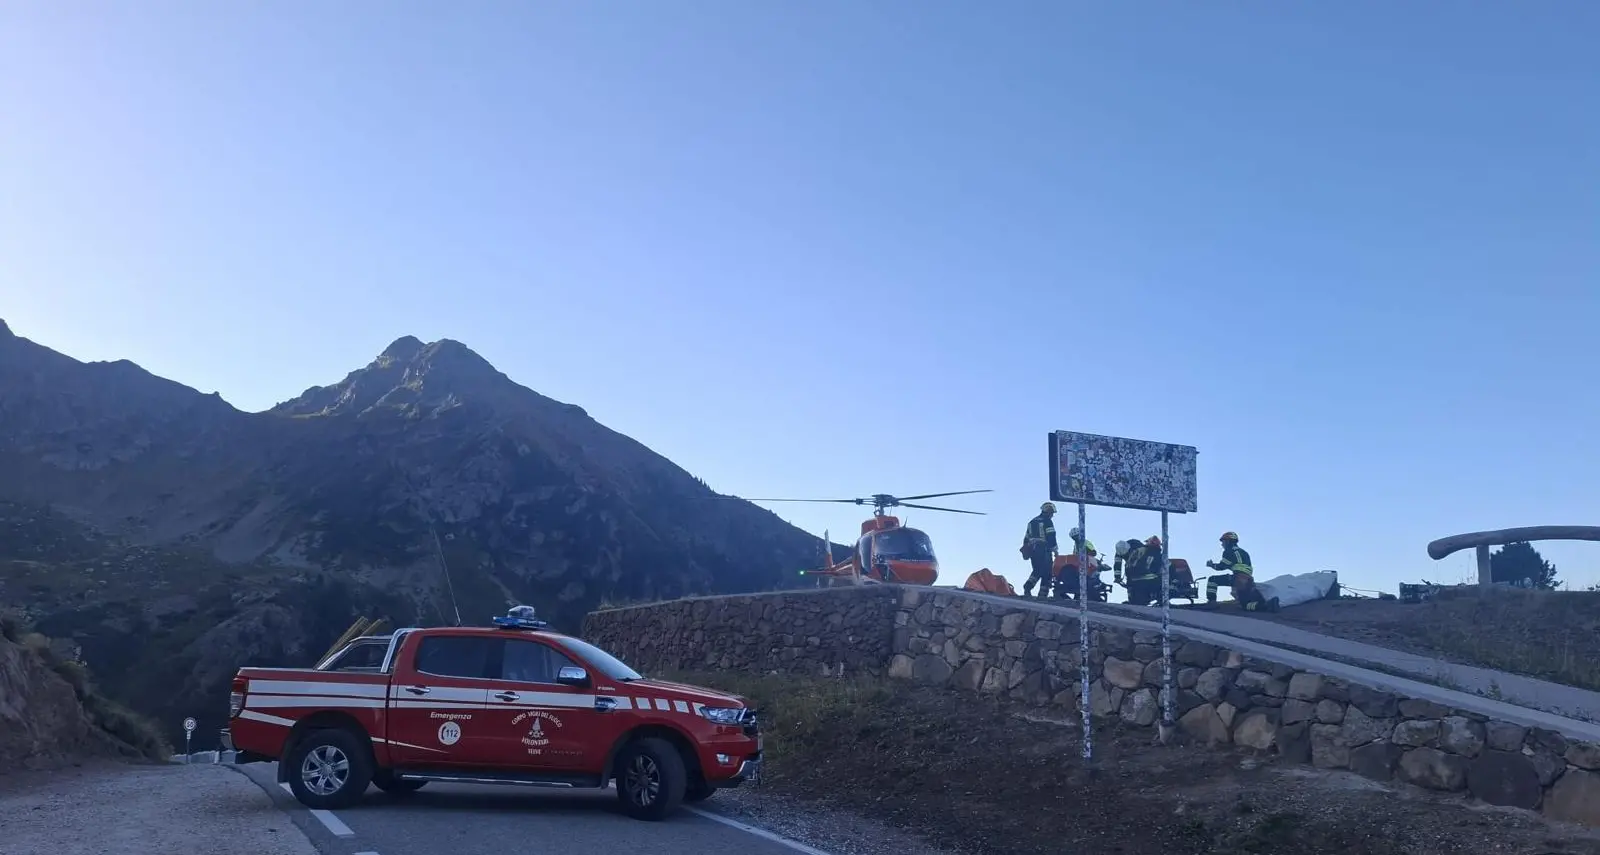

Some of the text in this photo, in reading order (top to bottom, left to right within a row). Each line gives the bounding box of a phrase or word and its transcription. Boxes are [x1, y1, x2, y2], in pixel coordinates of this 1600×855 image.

[430, 711, 472, 720] Emergenza
[511, 713, 526, 725] CORPO
[549, 714, 563, 728] FUOCO
[446, 729, 459, 738] 112
